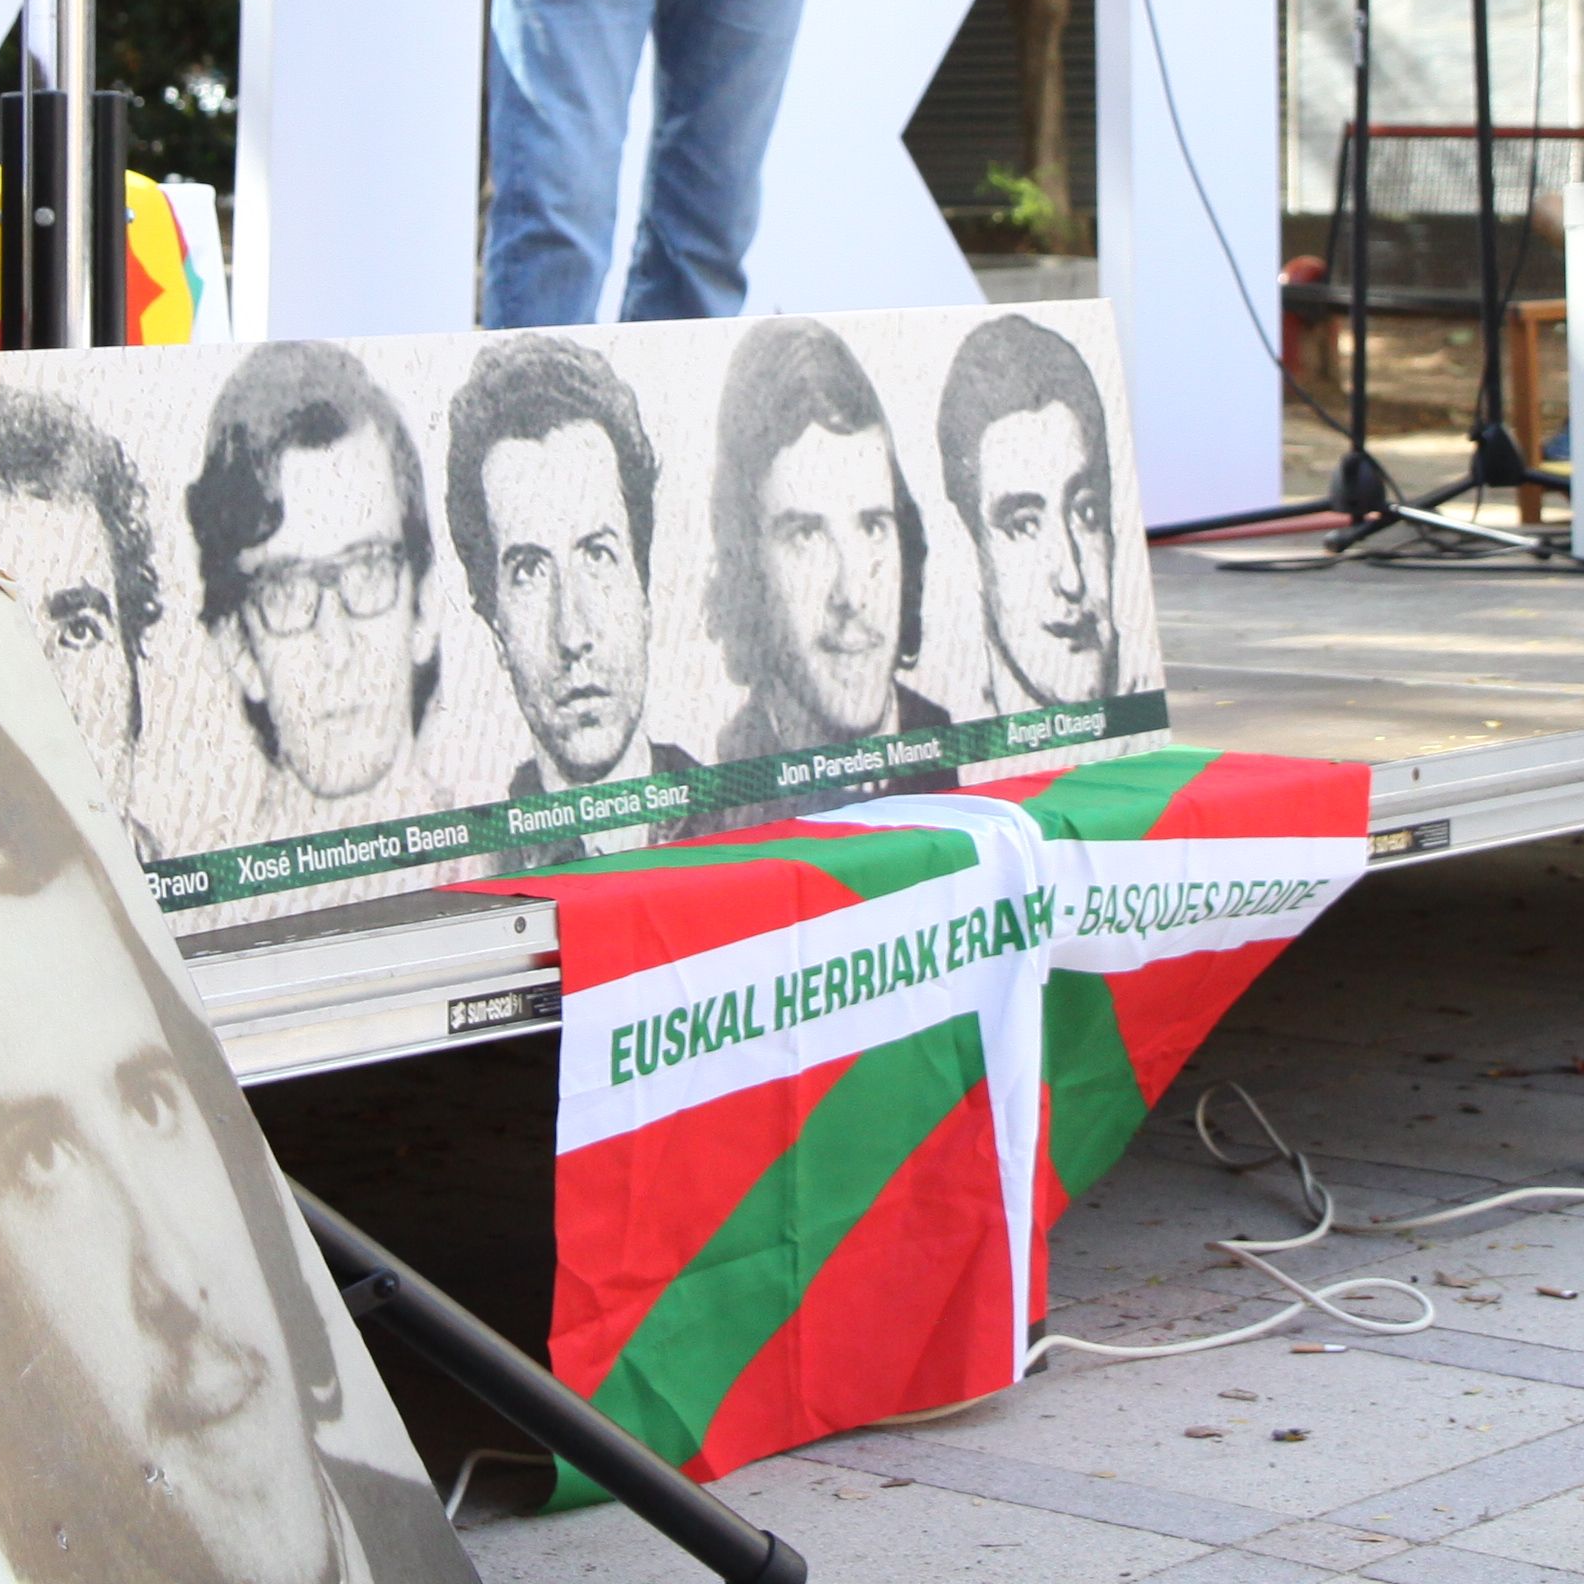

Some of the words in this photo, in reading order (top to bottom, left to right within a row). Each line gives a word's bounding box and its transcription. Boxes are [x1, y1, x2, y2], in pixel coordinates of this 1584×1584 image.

[1006, 715, 1052, 748] Ángel
[1055, 707, 1107, 737] Otaegi
[776, 761, 811, 786] Jon
[814, 747, 884, 779] Paredes
[887, 736, 942, 765] Manot
[507, 800, 575, 835] Ramón
[579, 789, 642, 821] García
[645, 783, 691, 808] Sanz
[237, 851, 291, 885] Xosé
[297, 834, 401, 874] Humberto
[406, 823, 469, 855] Baena
[146, 869, 210, 900] Bravo
[610, 984, 766, 1086] EUSKAL
[773, 923, 940, 1031] HERRIAK
[1077, 879, 1220, 940] BASQUES
[1207, 879, 1330, 921] DECIDE
